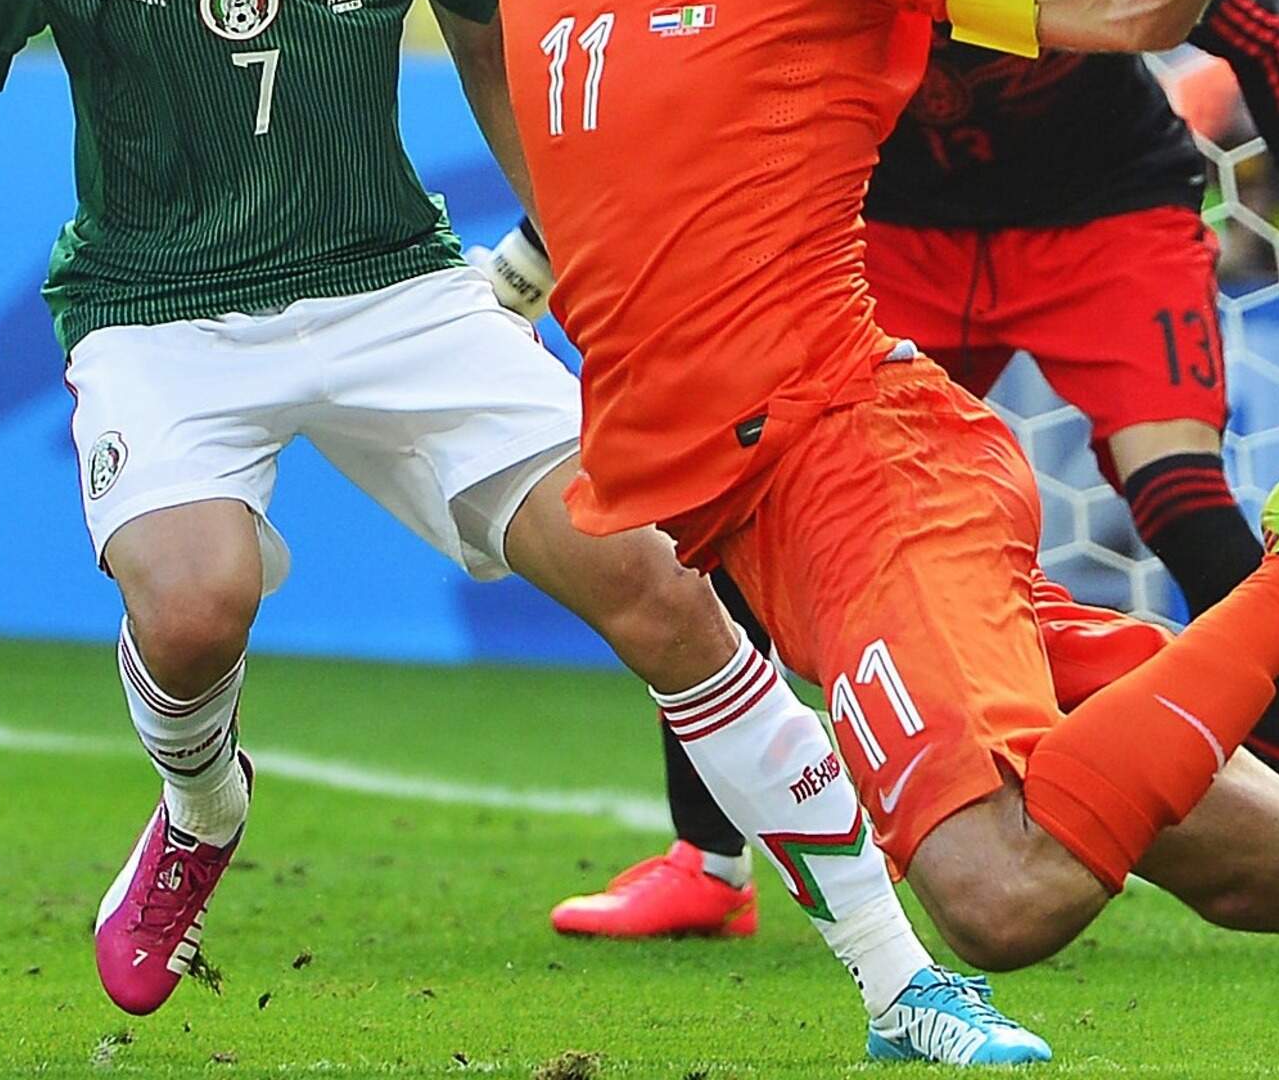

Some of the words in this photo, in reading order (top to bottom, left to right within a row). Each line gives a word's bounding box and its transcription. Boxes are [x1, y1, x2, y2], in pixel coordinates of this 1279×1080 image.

[231, 48, 280, 136] 7
[539, 12, 615, 137] 11
[1152, 308, 1219, 389] 13
[831, 637, 926, 772] 11
[132, 948, 149, 967] 7
